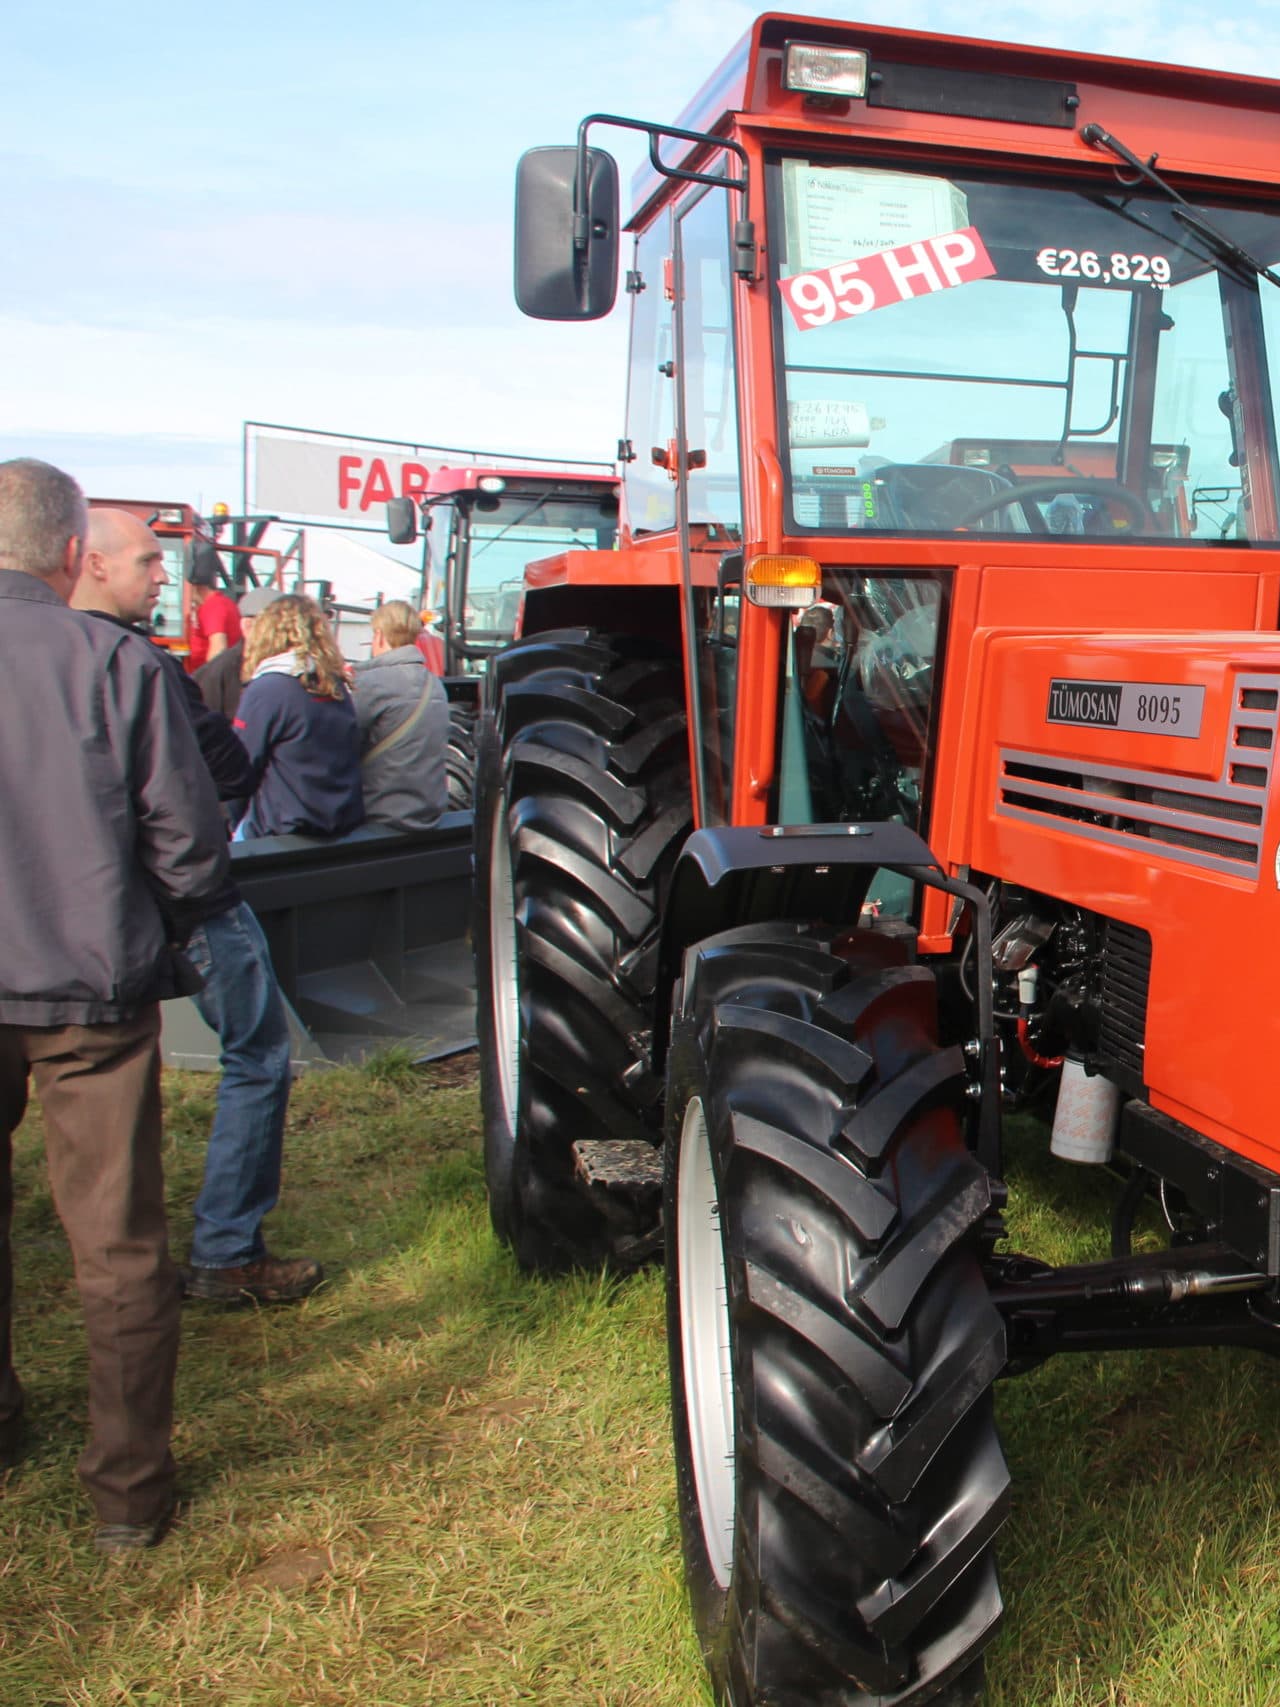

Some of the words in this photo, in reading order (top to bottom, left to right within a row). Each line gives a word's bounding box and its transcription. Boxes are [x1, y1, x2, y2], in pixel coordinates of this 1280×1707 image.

[788, 262, 876, 327] 95
[882, 232, 977, 301] HP
[1036, 248, 1171, 283] €26,829
[338, 455, 448, 512] FAR
[1052, 685, 1118, 722] TÜMOSAN
[1137, 694, 1182, 725] 8095
